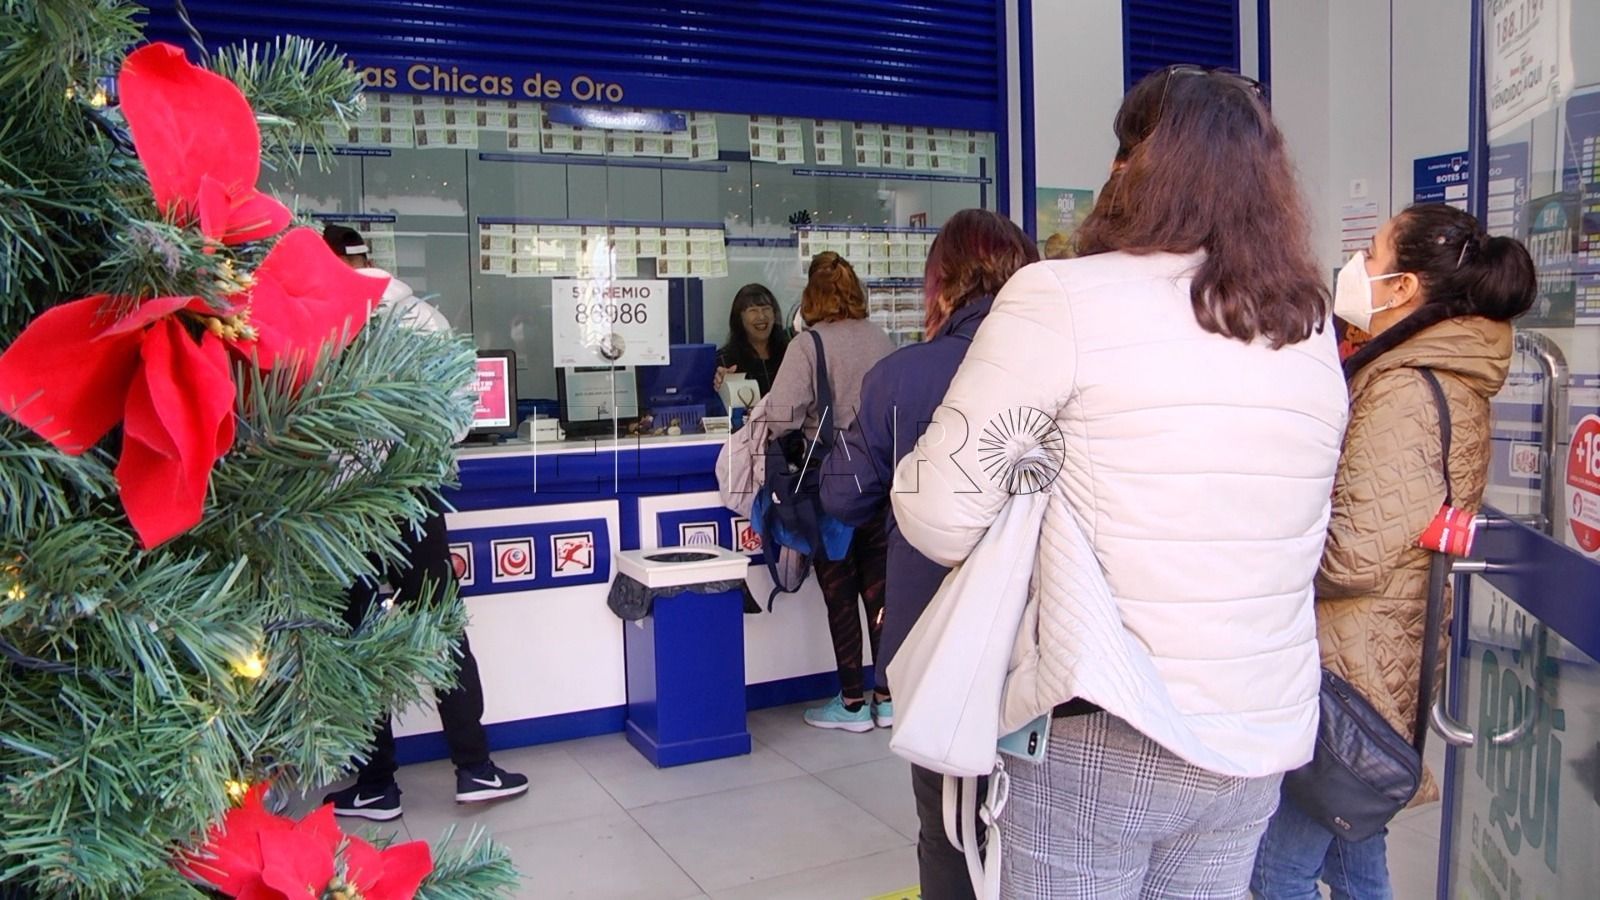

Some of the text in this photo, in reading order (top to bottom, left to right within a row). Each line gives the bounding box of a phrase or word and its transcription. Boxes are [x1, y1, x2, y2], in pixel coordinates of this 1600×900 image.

[407, 64, 513, 96] Chicas
[523, 73, 561, 98] de
[571, 76, 624, 102] Oro
[1490, 79, 1523, 112] VENDIDO
[1436, 173, 1461, 184] BOTES
[591, 286, 651, 299] PREMIO
[575, 302, 648, 325] 86986
